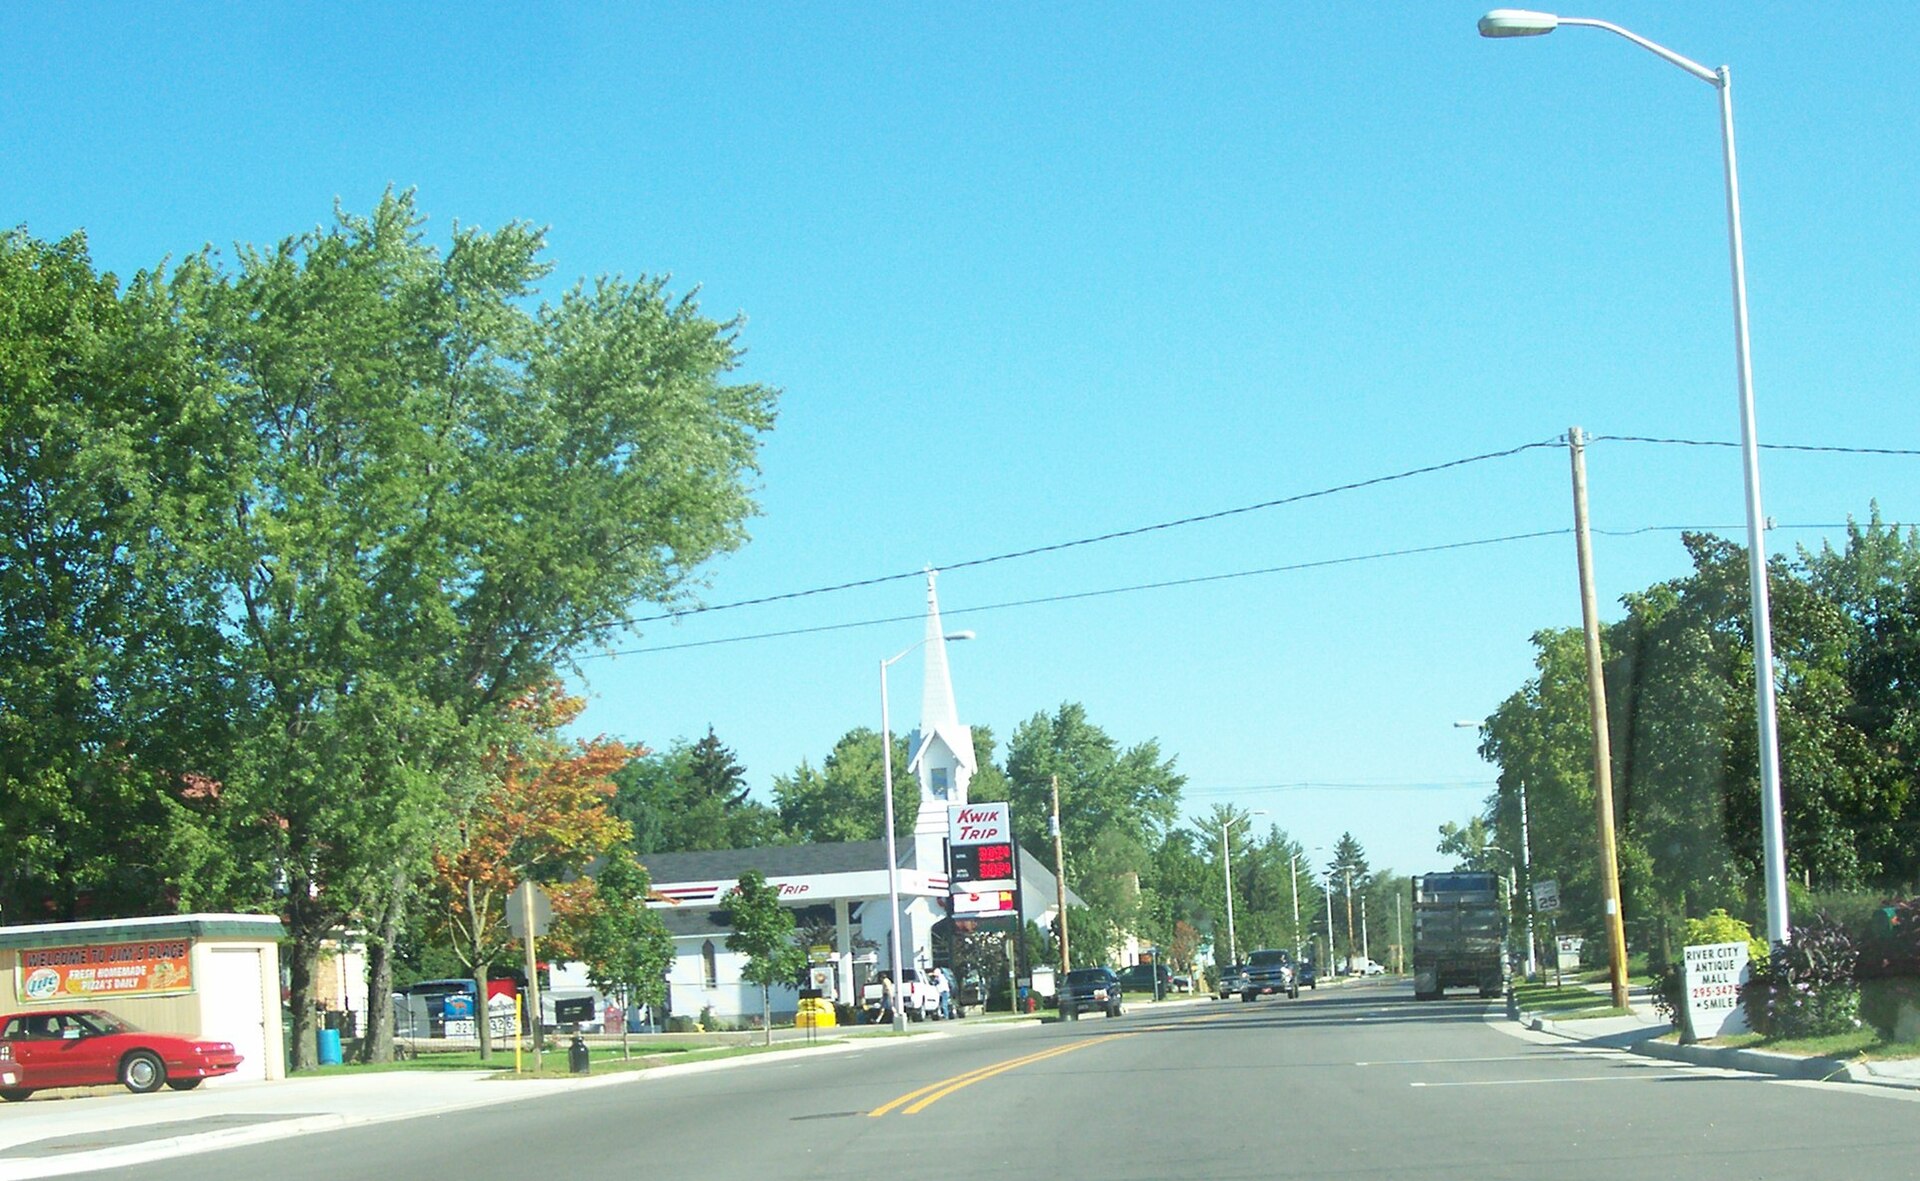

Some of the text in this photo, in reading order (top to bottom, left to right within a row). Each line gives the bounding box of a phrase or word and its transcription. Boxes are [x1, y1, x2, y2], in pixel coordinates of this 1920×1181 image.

[957, 808, 999, 824] KWIK
[960, 826, 998, 840] TRIP
[777, 883, 809, 896] TRIP
[1539, 895, 1557, 909] 25
[28, 944, 184, 968] WELCOME TO JIM'S PLACE
[1686, 947, 1739, 961] RIVER CITY
[68, 965, 147, 981] FRESH HOMEMADE
[1695, 960, 1735, 973] ANTIQUE
[81, 977, 139, 991] PIZZA'S DAILY
[1702, 972, 1729, 984] MALL
[1703, 998, 1733, 1009] SMILE
